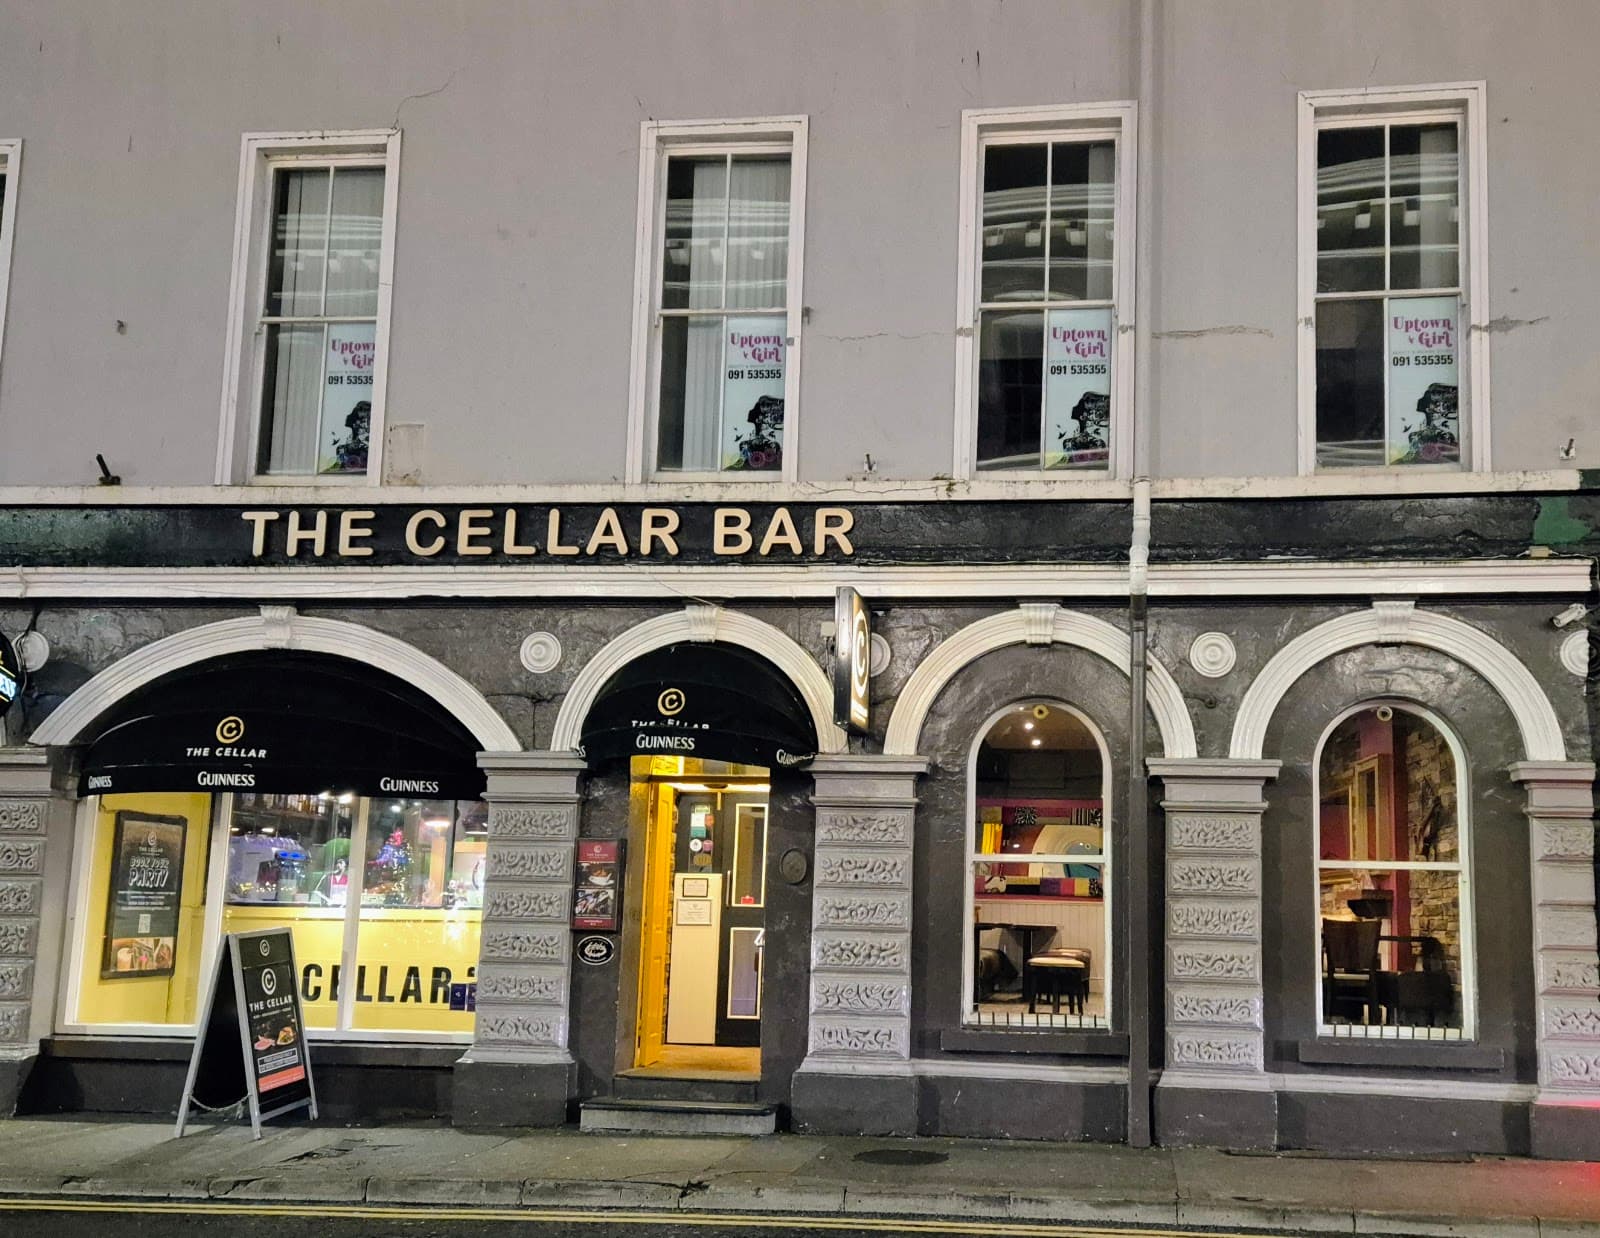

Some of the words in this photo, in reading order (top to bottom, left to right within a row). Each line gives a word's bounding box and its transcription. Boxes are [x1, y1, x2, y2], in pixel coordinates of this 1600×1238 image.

[1393, 316, 1453, 333] Uptown
[730, 332, 783, 348] Uptown
[1052, 327, 1107, 343] Uptown
[1418, 331, 1453, 348] Girl
[751, 347, 782, 363] Girl
[1074, 341, 1106, 358] Girl
[351, 353, 374, 369] Gir
[1392, 356, 1410, 367] 091
[1414, 354, 1454, 366] 535355
[728, 370, 744, 380] 091
[747, 369, 782, 379] 535355
[1050, 365, 1067, 375] 091
[1070, 364, 1107, 375] 535355
[328, 375, 343, 385] 091
[241, 509, 375, 558] THE
[404, 507, 681, 558] CELLAR
[712, 507, 856, 557] BAR
[635, 733, 696, 751] GUINNESS
[186, 747, 211, 758] THE
[215, 747, 268, 759] CELLAR
[197, 770, 256, 787] GUINNESS
[379, 776, 440, 793] GUINNESS
[128, 867, 169, 888] PARTY
[249, 1000, 265, 1013] THE
[266, 993, 293, 1009] CELLAR
